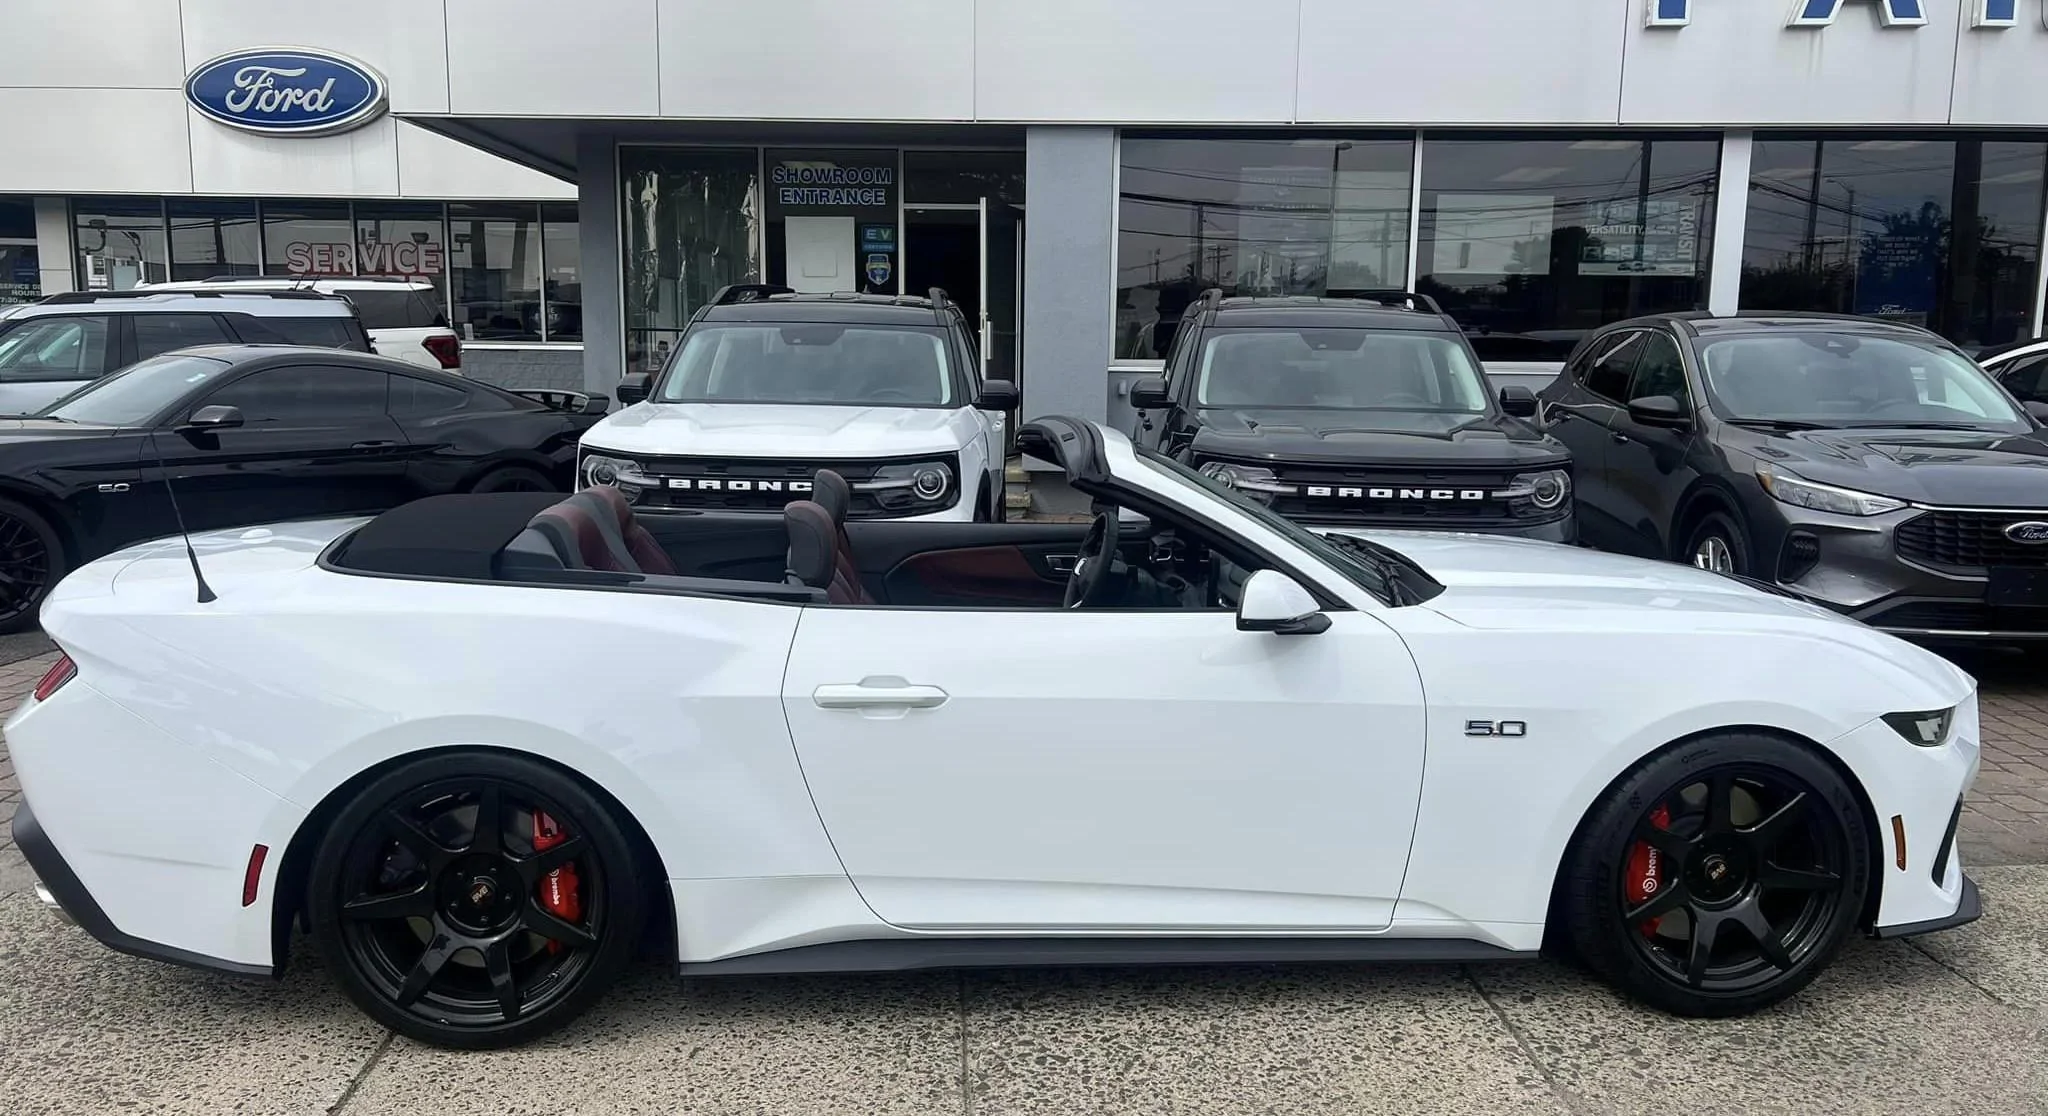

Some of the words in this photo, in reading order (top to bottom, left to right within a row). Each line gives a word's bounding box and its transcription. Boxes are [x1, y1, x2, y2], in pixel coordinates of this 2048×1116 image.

[225, 66, 336, 113] Ford
[772, 166, 892, 185] SHOWROOM
[779, 187, 887, 206] ENTRANCE
[866, 228, 892, 240] EV
[286, 241, 443, 275] SERVICE
[668, 478, 813, 492] BRONC
[1307, 486, 1484, 500] BRONCO
[1464, 719, 1527, 738] 5.0
